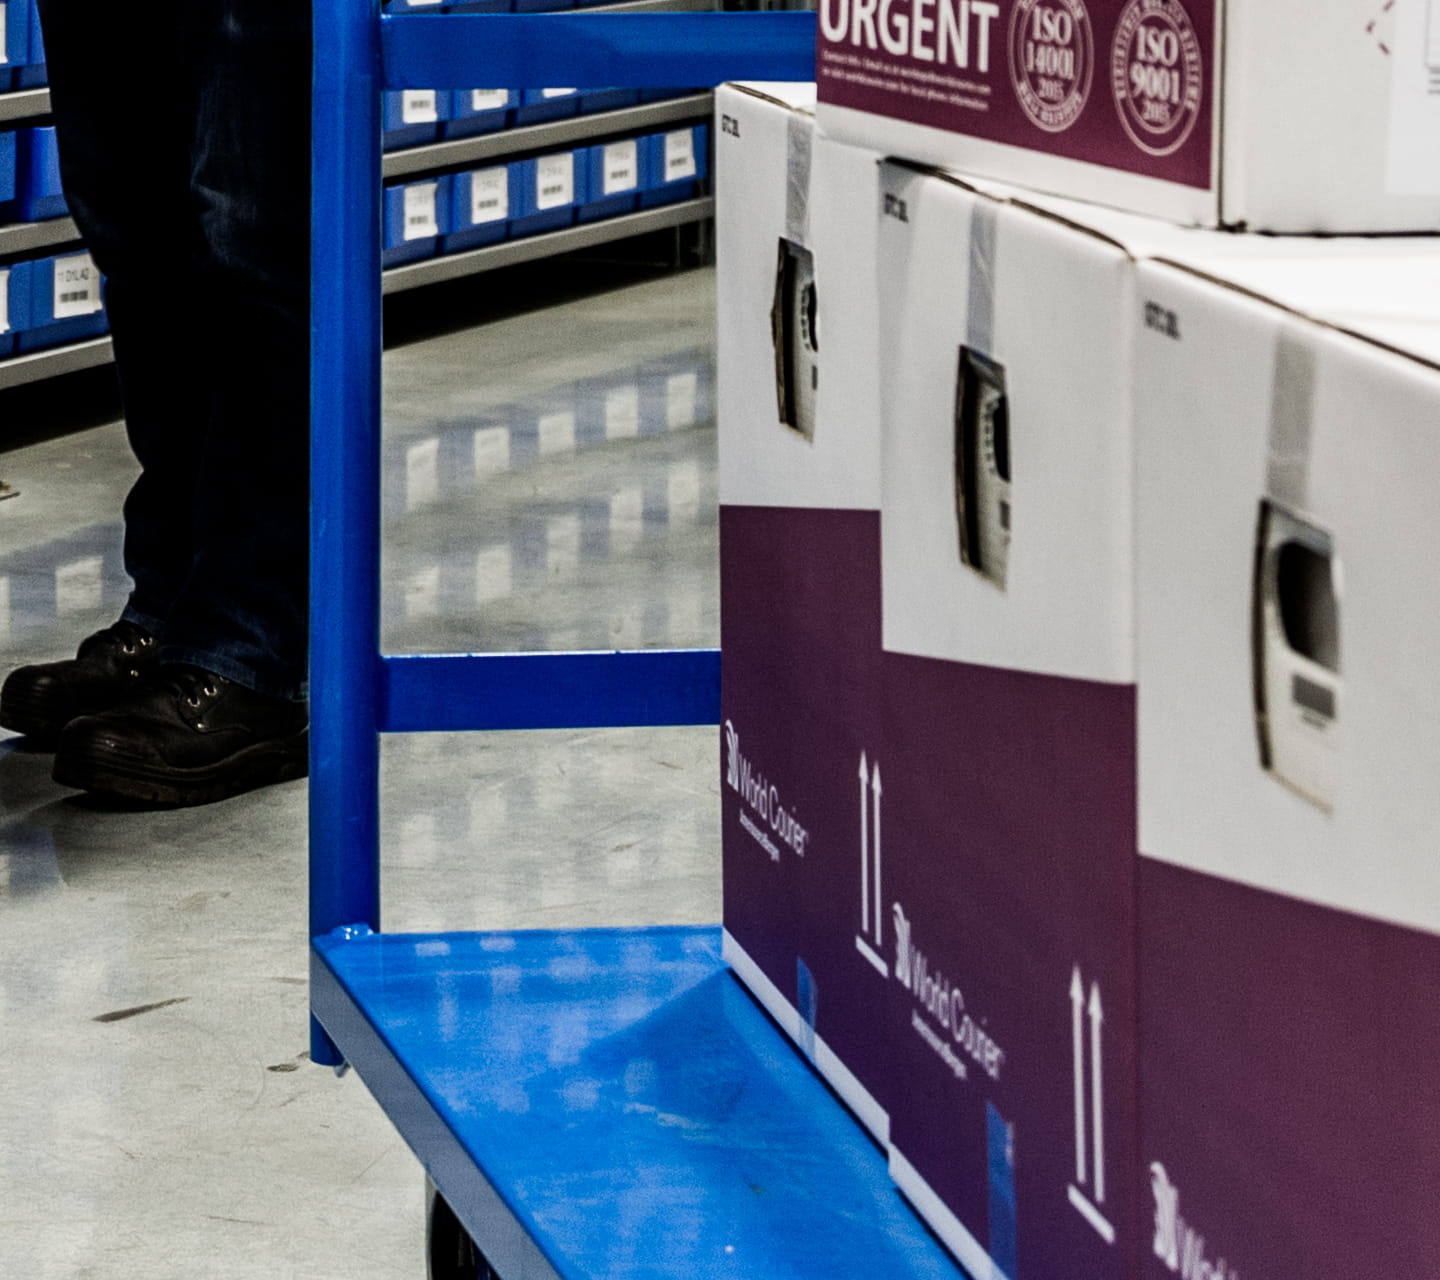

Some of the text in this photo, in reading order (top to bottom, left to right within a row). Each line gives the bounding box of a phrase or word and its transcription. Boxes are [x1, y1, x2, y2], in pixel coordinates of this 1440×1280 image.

[1033, 5, 1072, 46] ISO
[1137, 25, 1179, 67] ISO
[1130, 61, 1180, 105] 9001
[738, 752, 768, 821] World
[770, 785, 805, 857] Courier
[909, 940, 950, 1029] World
